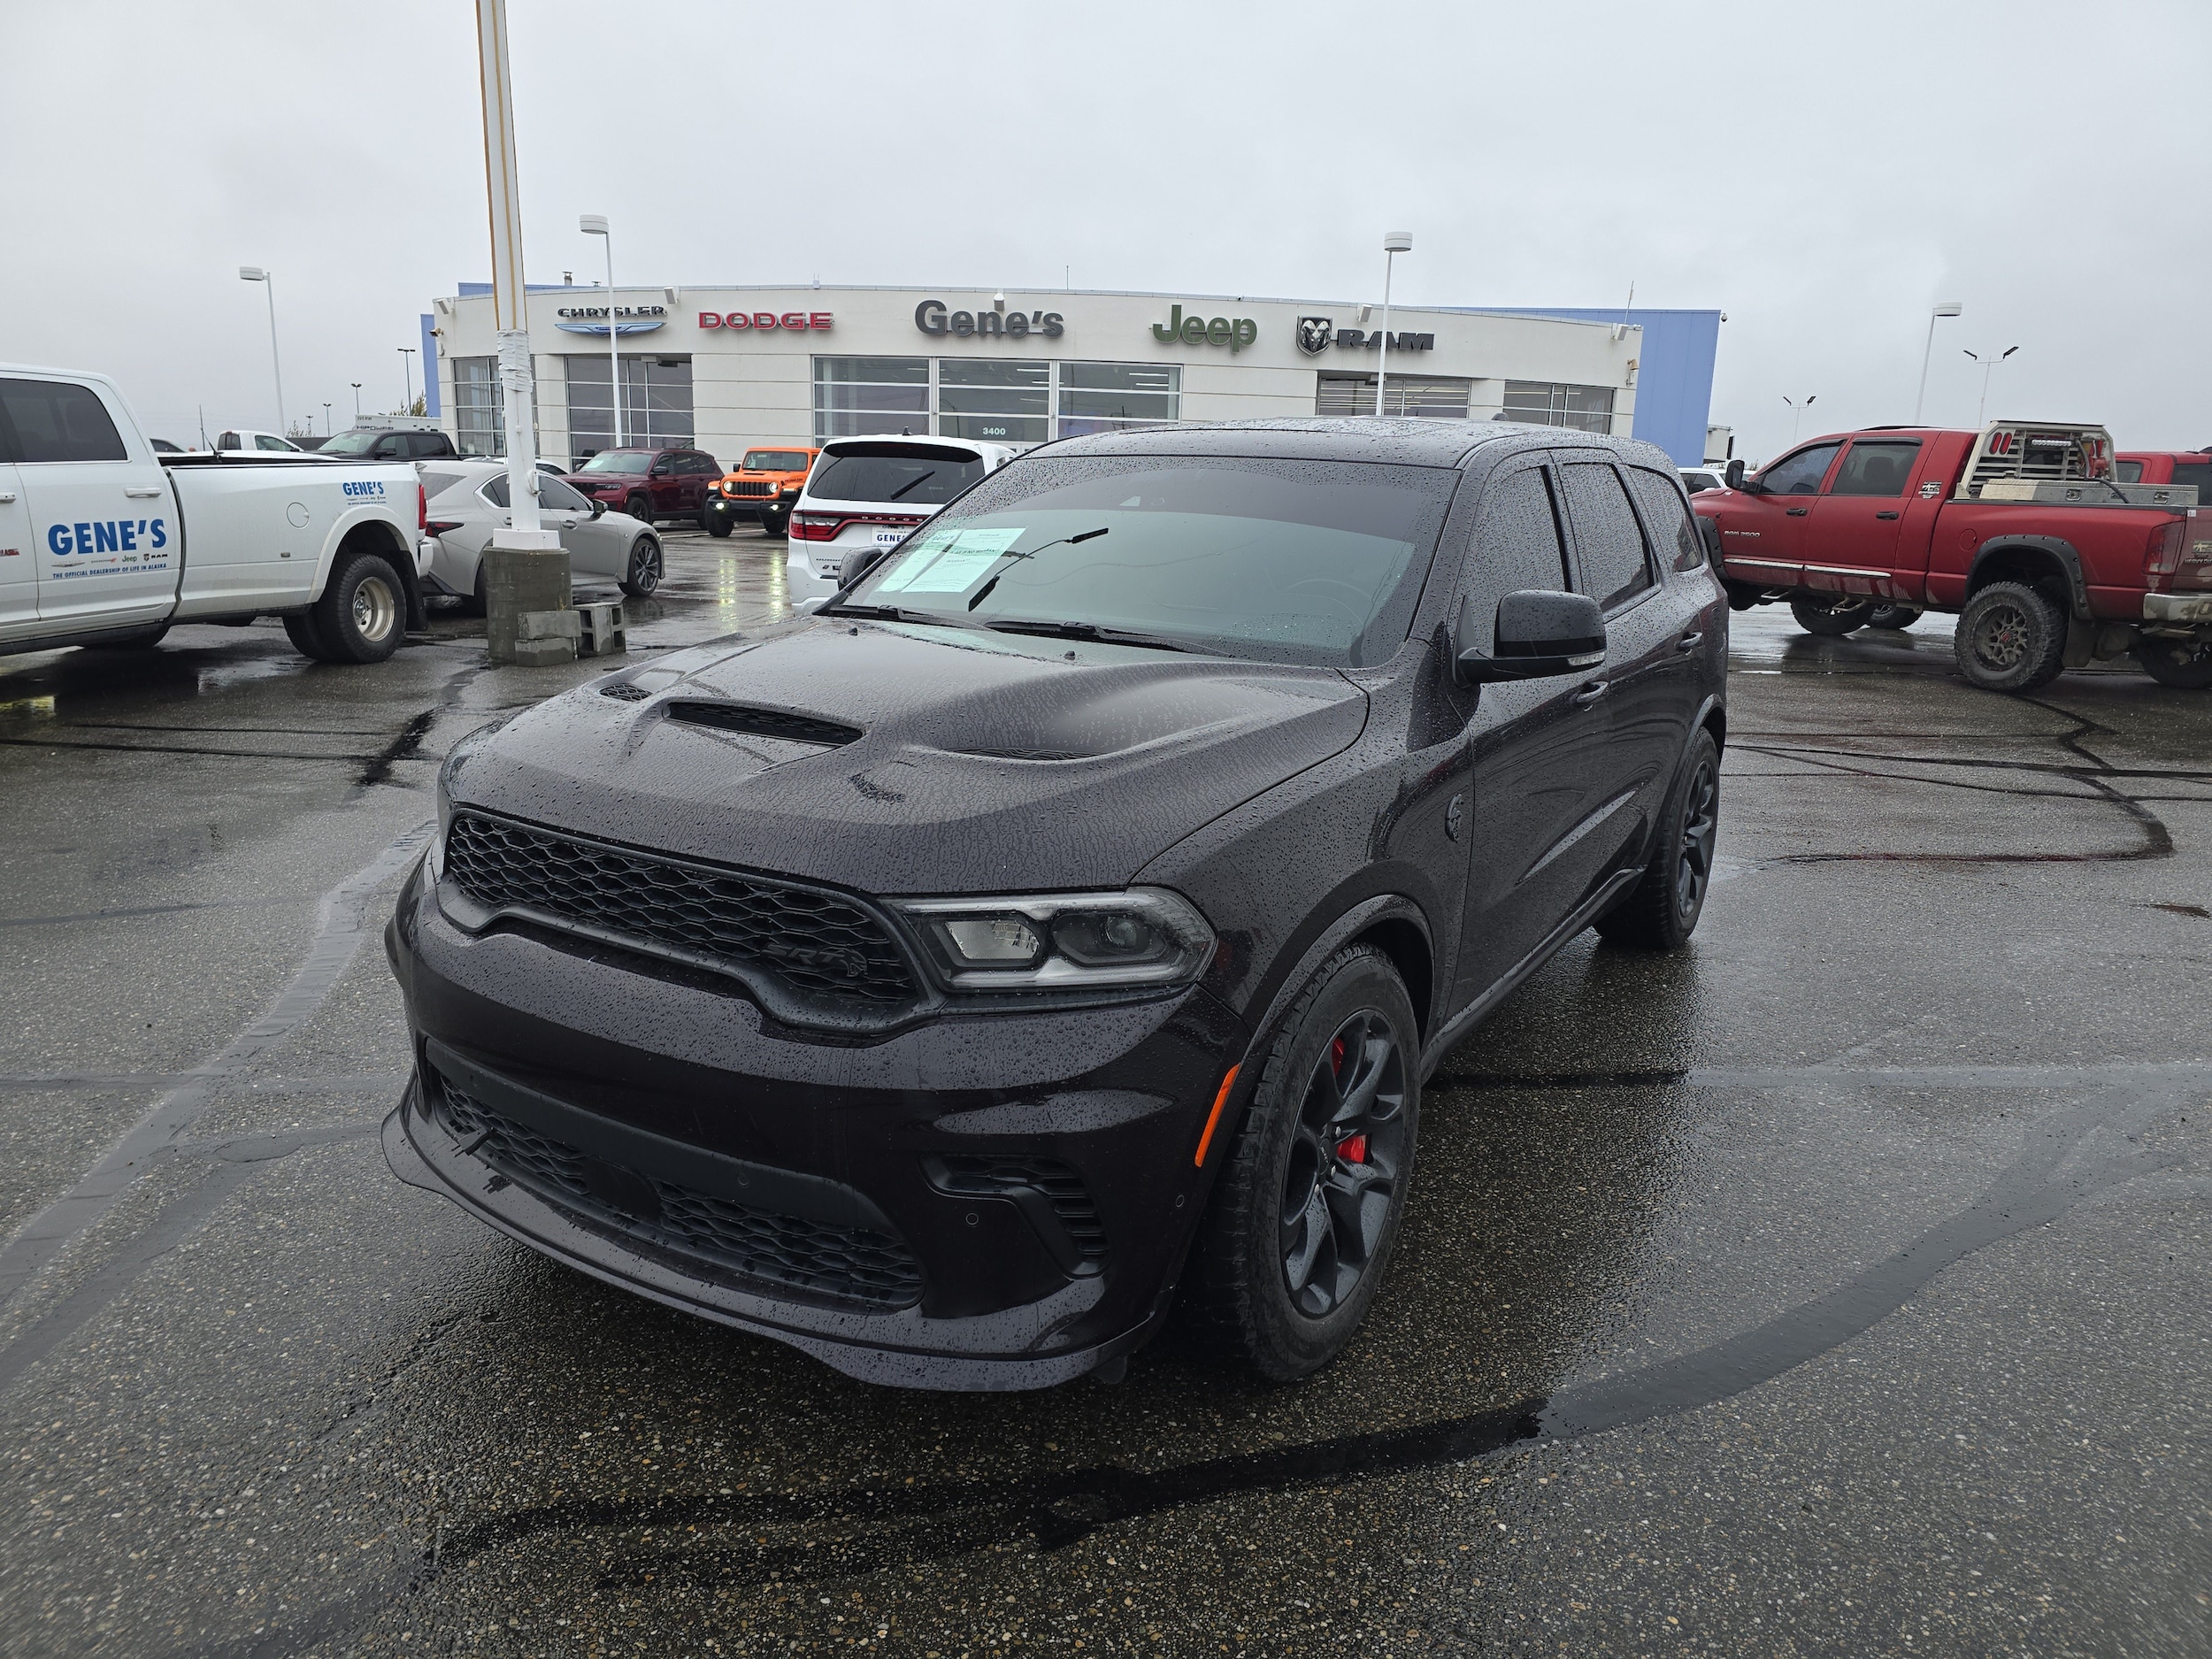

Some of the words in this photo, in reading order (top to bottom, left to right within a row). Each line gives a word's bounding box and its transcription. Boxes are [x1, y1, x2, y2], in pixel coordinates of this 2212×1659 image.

[557, 305, 664, 318] CHRYSLER
[698, 311, 834, 330] DODGE
[915, 299, 1064, 338] Gene's
[1152, 304, 1257, 352] Jeep
[1336, 328, 1434, 350] RAM
[982, 426, 1006, 435] 3400
[342, 481, 384, 495] GENE'S
[48, 518, 166, 556] GENE'S
[761, 944, 845, 965] SRT
